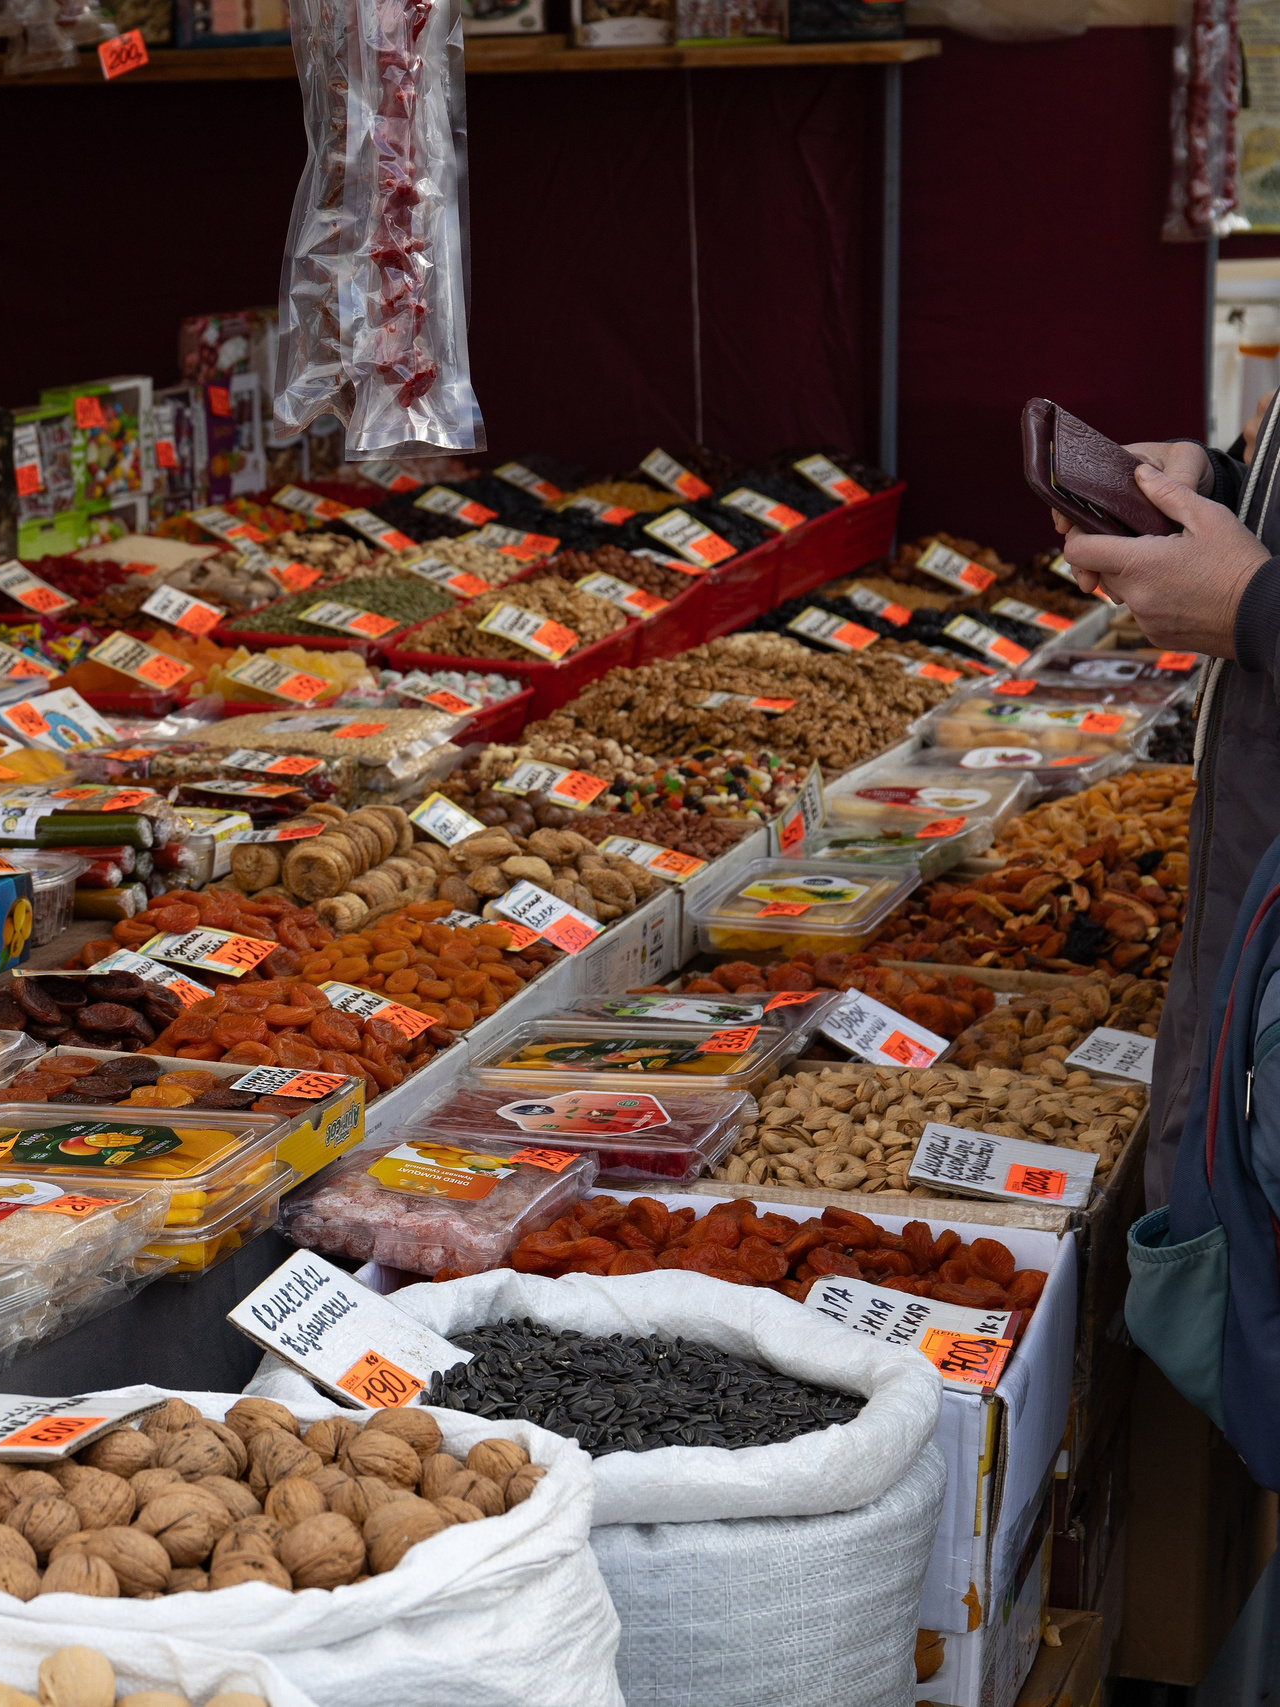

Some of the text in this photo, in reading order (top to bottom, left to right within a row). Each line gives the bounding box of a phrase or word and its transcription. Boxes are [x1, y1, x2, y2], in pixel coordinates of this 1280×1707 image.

[397, 1167, 470, 1187] DRIED KUMQUAT
[250, 1265, 331, 1331] Семечки
[816, 1286, 854, 1323] АГА
[280, 1290, 358, 1357] Кубанские
[885, 1302, 931, 1345] ЕКСКАЯ
[932, 1329, 962, 1338] ЦЕНА
[343, 1373, 361, 1390] ЦЕНА
[360, 1369, 408, 1409] 190
[31, 1419, 86, 1443] 600
